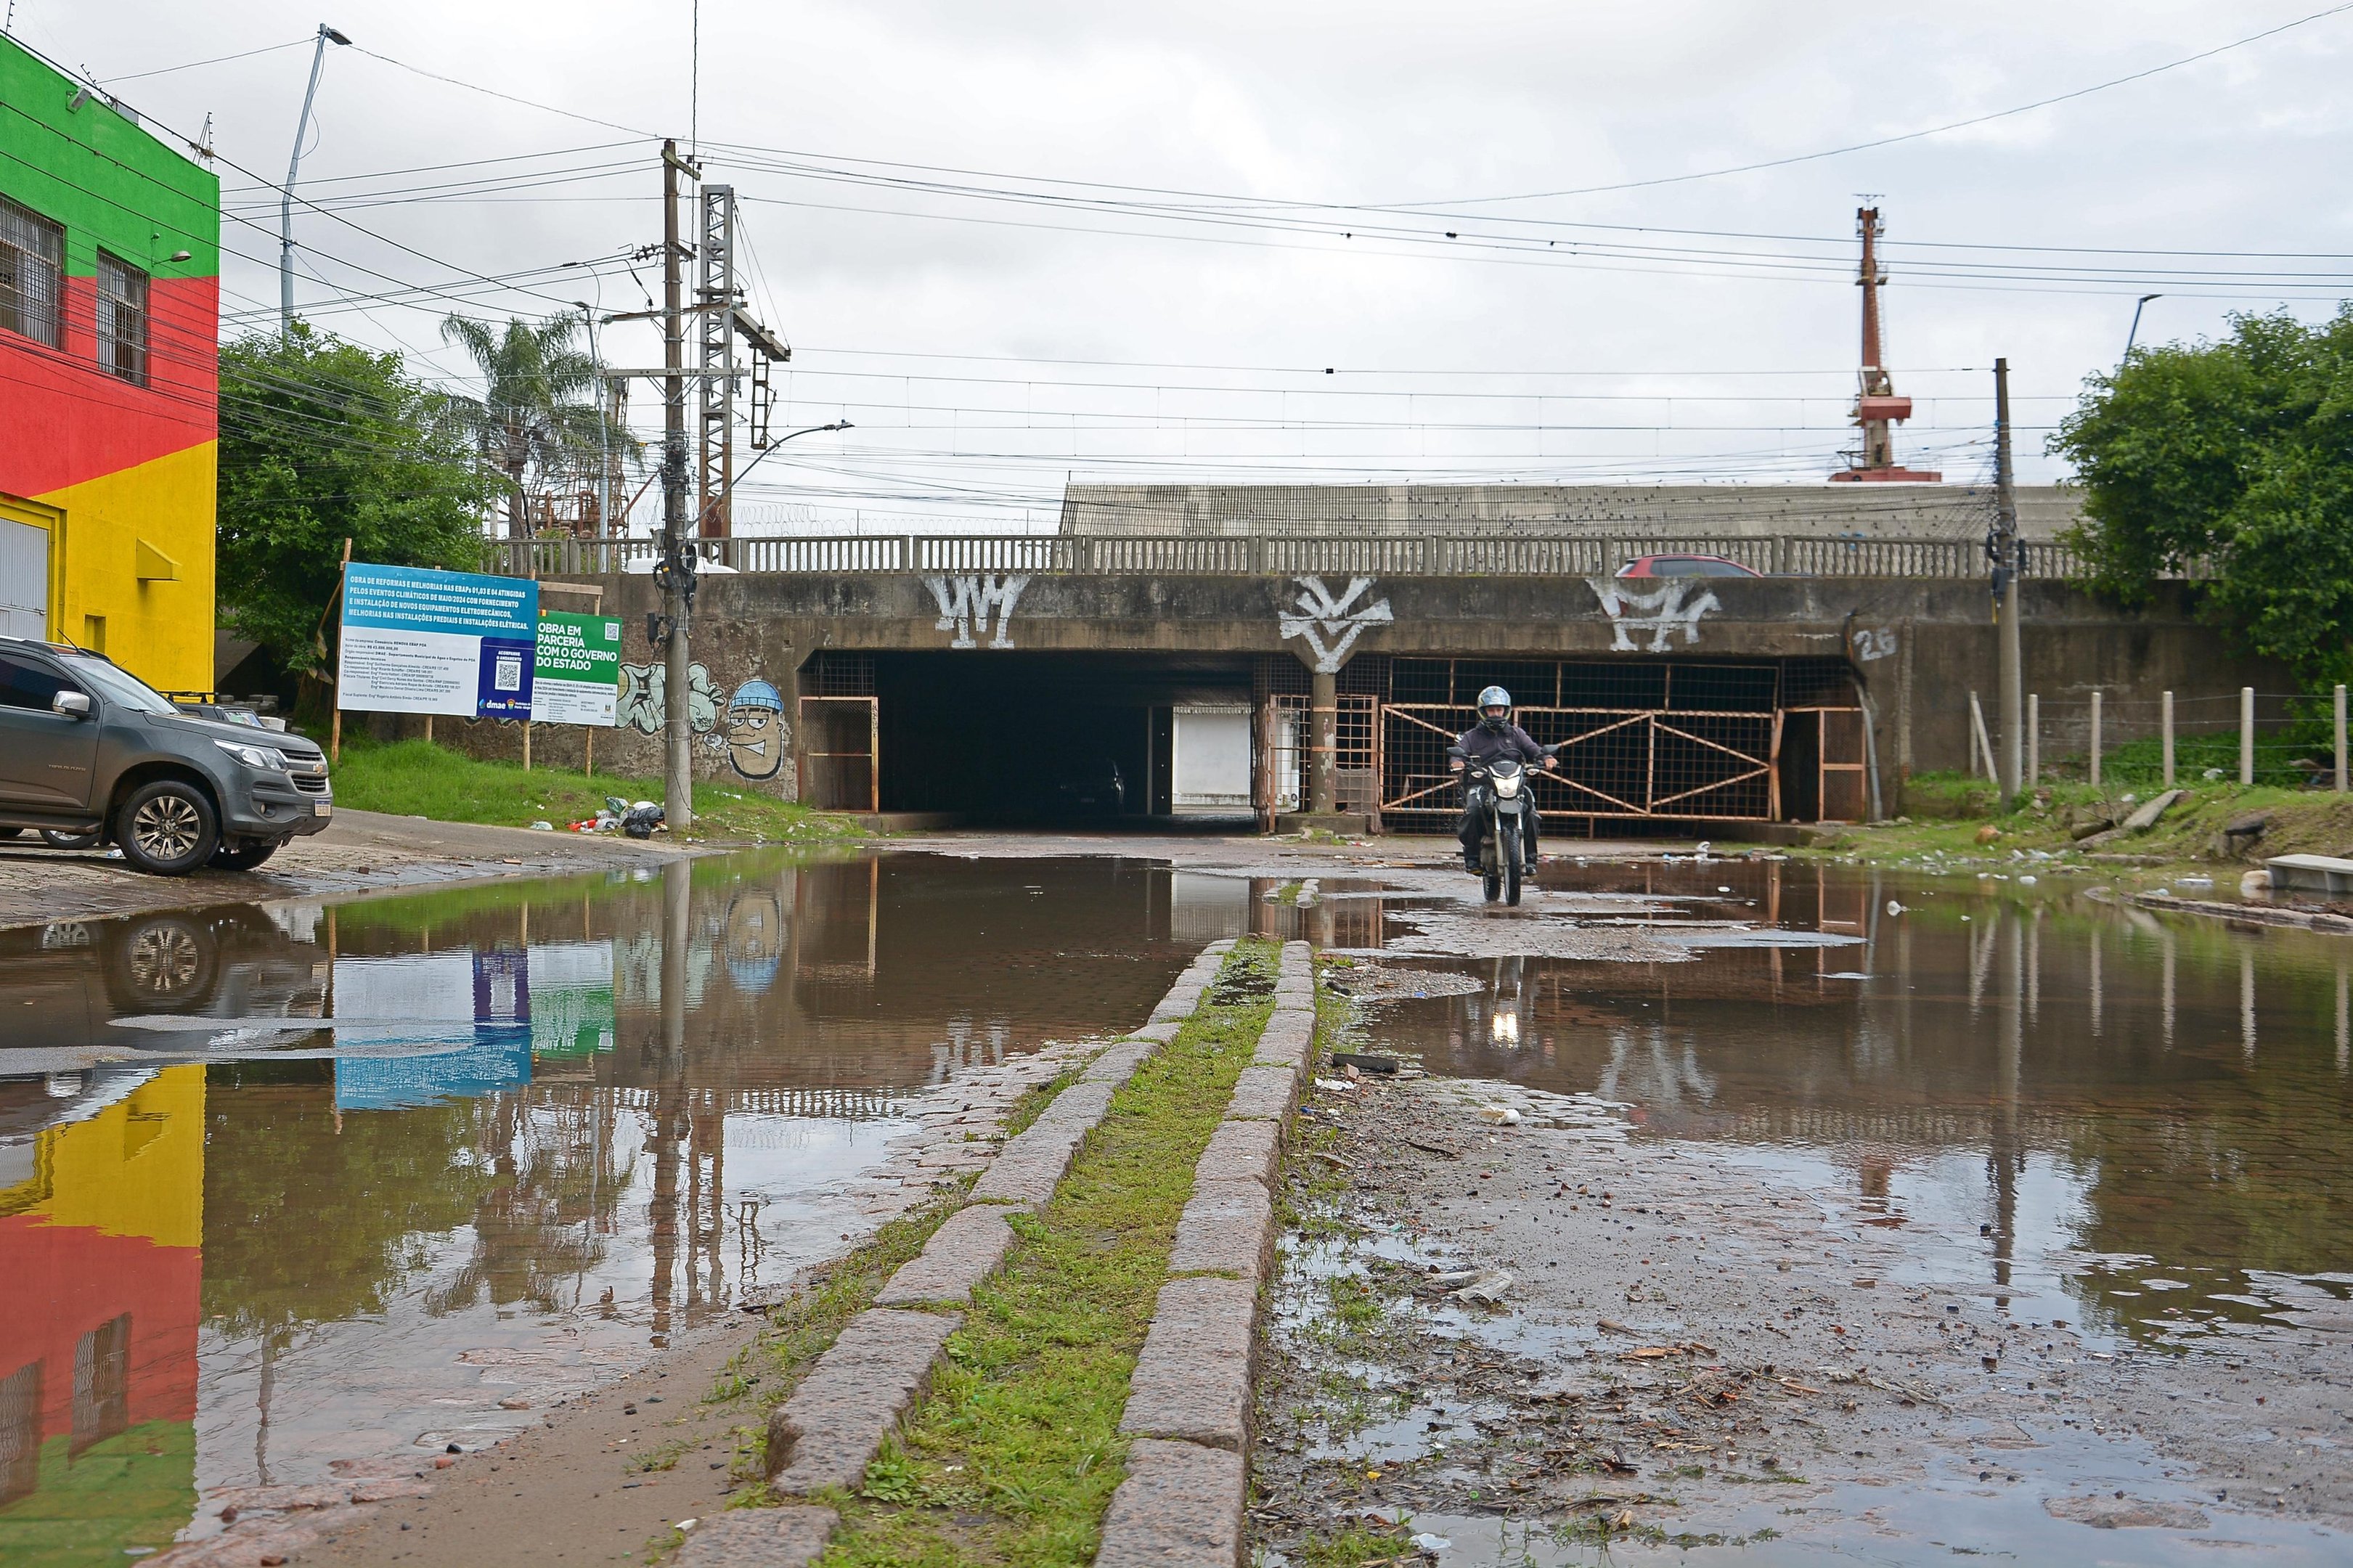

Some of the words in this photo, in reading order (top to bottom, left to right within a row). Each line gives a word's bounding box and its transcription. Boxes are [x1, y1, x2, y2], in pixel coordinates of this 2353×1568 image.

[376, 578, 405, 587] REFORMAS
[412, 581, 442, 590] MELHORIAS
[498, 589, 526, 598] ATINGIDAS
[396, 591, 429, 600] CLIMÁTICOS
[439, 595, 465, 604] MAIO/2024
[478, 598, 518, 608] FORNECIMENTO
[354, 599, 389, 608] INSTALAÇÃO
[419, 603, 460, 613] EQUIPAMENTOS
[461, 608, 512, 618] ELETROMECÂNICOS,
[395, 613, 432, 622] INSTALAÇÕES
[463, 618, 498, 628] INSTALAÇÕES
[499, 620, 528, 629] ELÉTRICAS.
[538, 623, 565, 634] OBRA
[568, 626, 581, 636] EM
[537, 634, 584, 648] PARCERIA
[537, 646, 559, 656] COM
[561, 648, 568, 658] O
[571, 649, 617, 661] GOVERNO
[537, 657, 551, 667] DO
[553, 658, 591, 671] ESTADO
[486, 700, 505, 709] dmae
